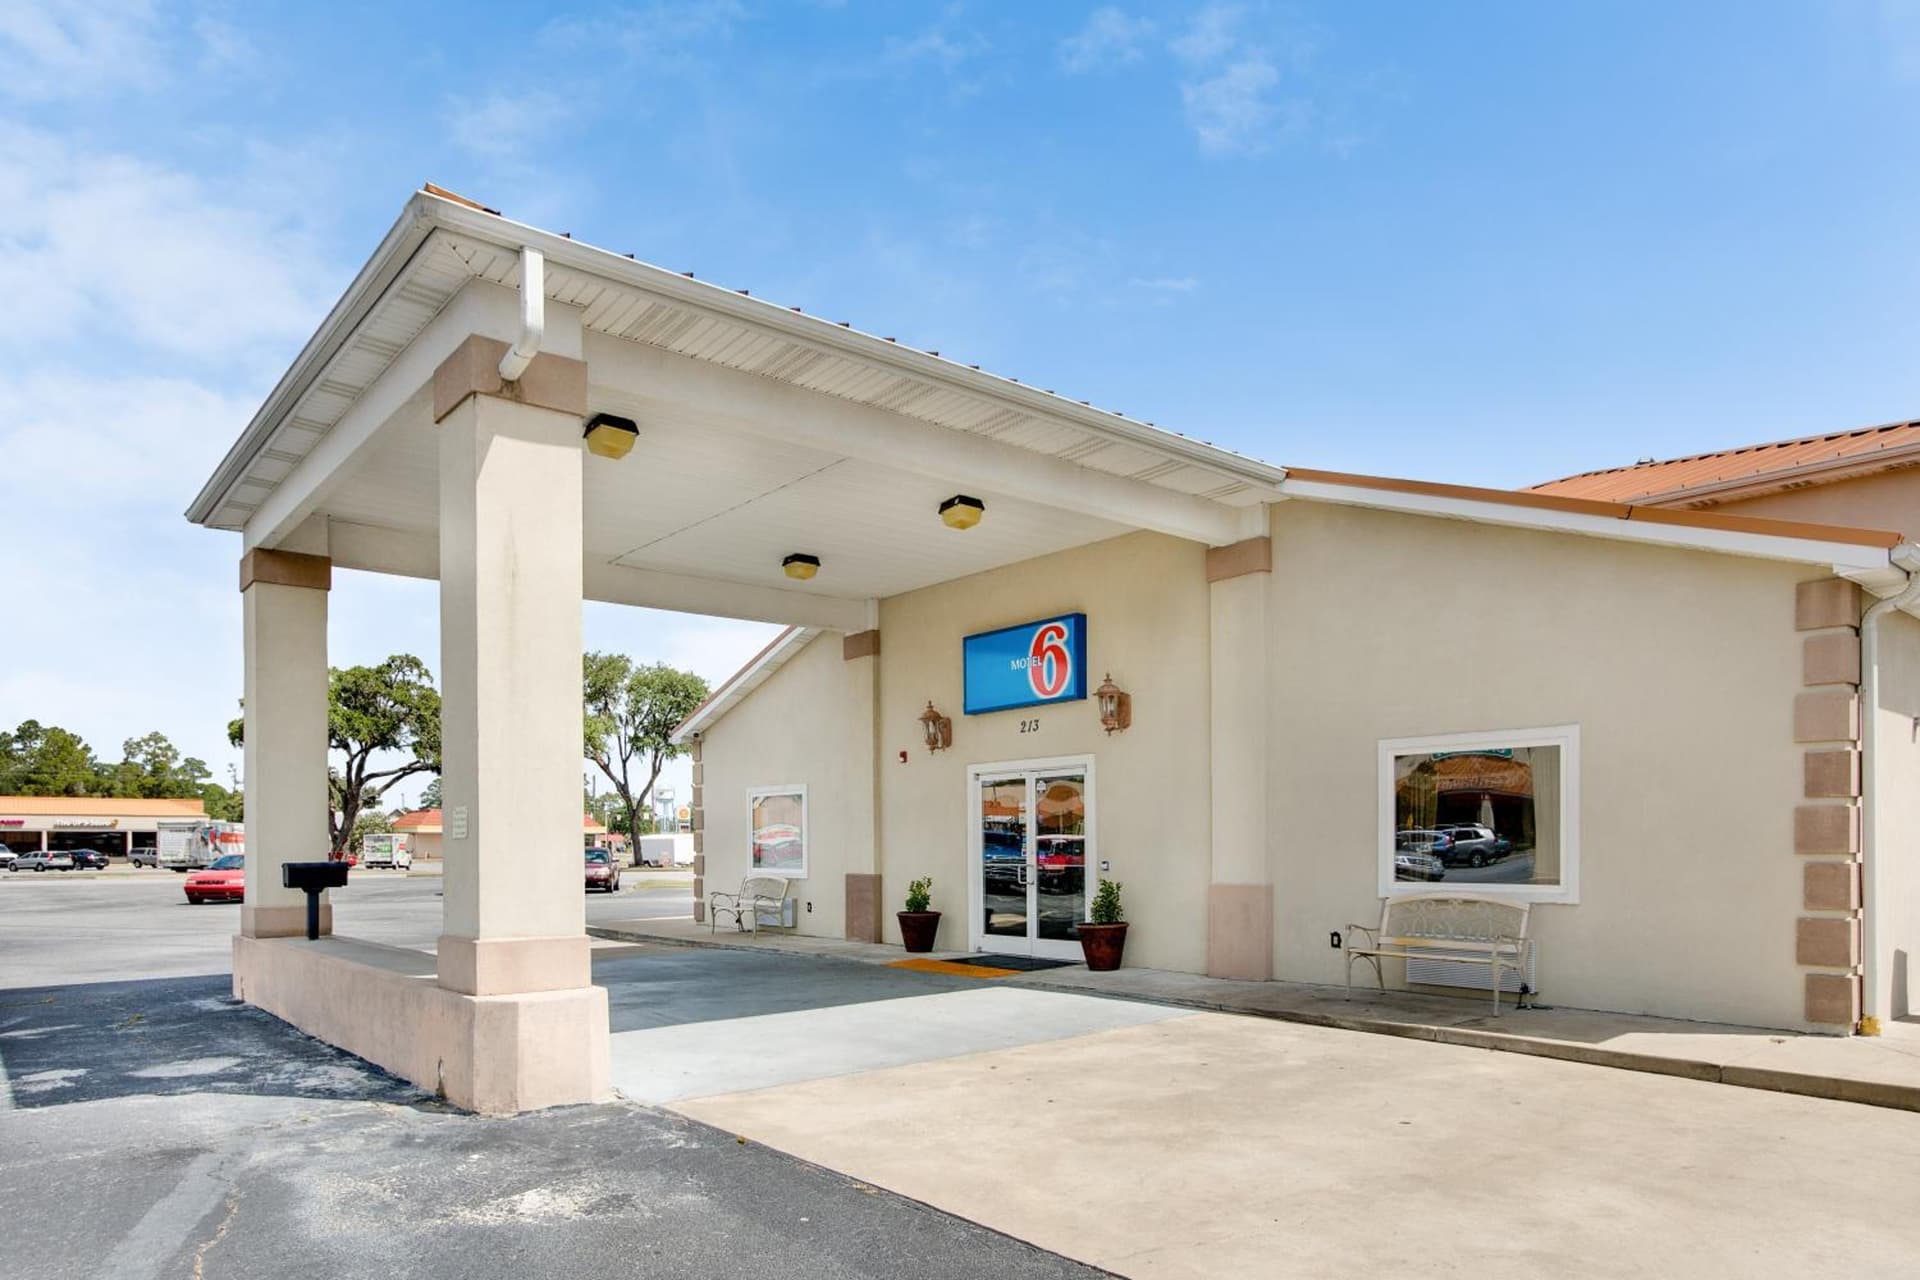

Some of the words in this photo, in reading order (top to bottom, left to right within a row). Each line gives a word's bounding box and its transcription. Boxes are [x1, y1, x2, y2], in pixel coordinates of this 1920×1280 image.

[1010, 656, 1042, 670] MOTEL
[1029, 622, 1071, 699] 6
[1020, 719, 1040, 733] 213
